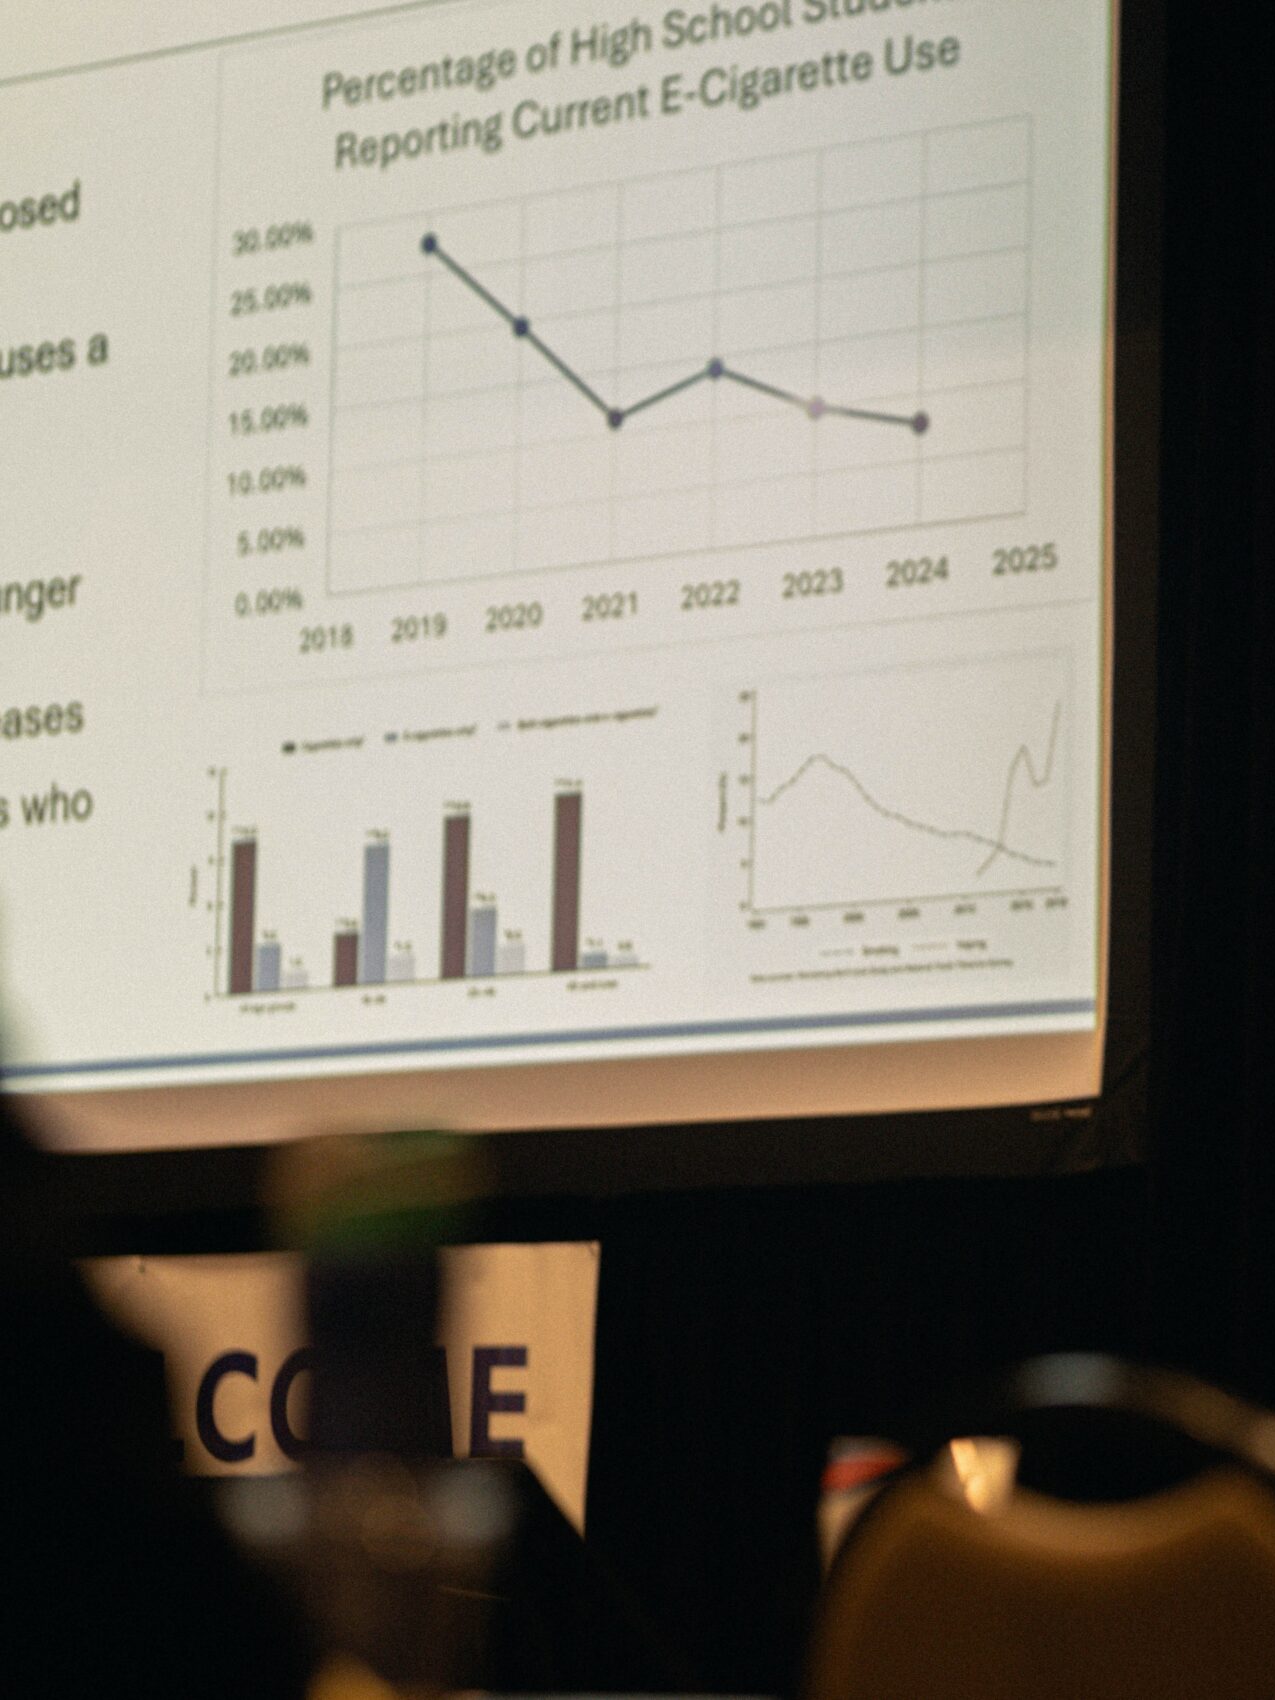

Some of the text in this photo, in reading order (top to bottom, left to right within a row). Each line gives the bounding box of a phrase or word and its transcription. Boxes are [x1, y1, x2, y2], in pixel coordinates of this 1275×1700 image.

[322, 48, 517, 111] Percentage
[525, 30, 563, 73] of
[570, 17, 652, 69] High
[662, 0, 792, 49] School
[335, 35, 961, 171] Reporting Current E-Cigarette Use
[232, 220, 313, 257] 30.00%
[229, 282, 311, 317] 25.00%
[87, 332, 109, 367] a
[228, 342, 310, 378] 20.00%
[229, 403, 310, 436] 15.00%
[227, 464, 307, 497] 10.00%
[236, 526, 306, 558] 5.00%
[234, 587, 304, 618] 0.00%
[300, 543, 1059, 655] 2018 2019 2020 2021 2022 2023 2024 2025
[20, 783, 94, 826] who
